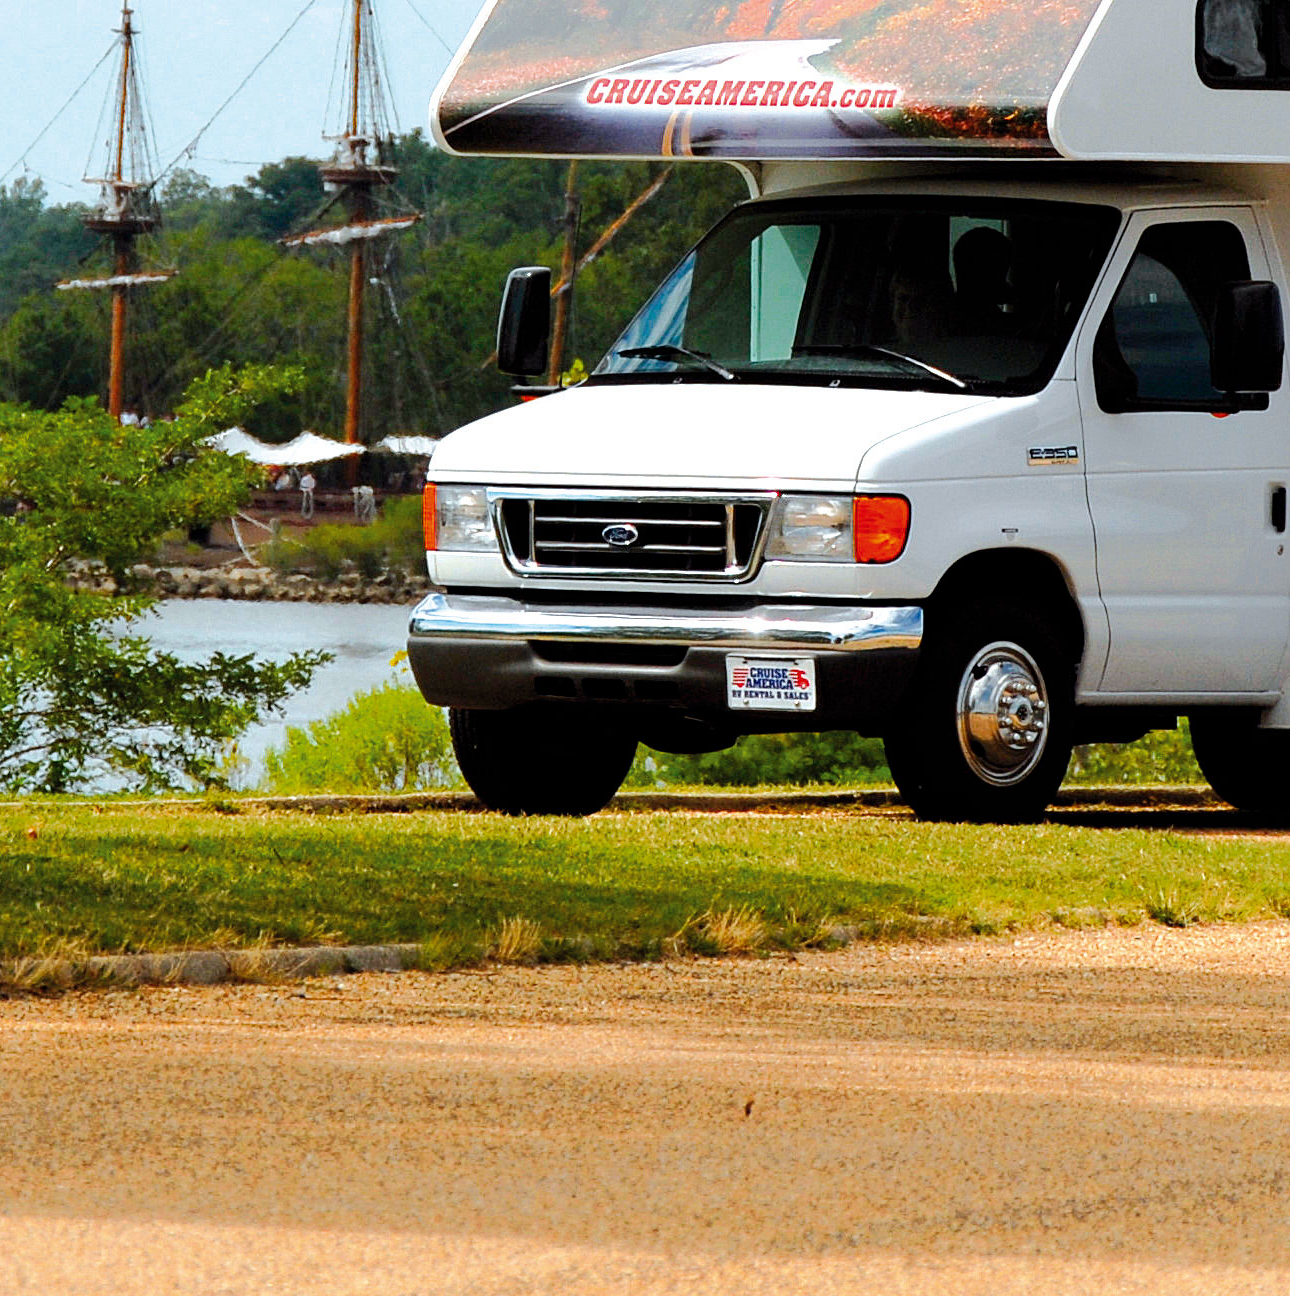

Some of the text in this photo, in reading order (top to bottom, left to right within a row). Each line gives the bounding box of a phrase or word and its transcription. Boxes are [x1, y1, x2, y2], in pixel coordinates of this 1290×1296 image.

[586, 77, 898, 109] CRUISEAMERICA.com
[750, 667, 788, 679] CRUISE
[746, 678, 794, 690] AMERICA
[732, 690, 742, 698] RV
[744, 690, 775, 699] RENTAL
[784, 692, 809, 700] SALES
